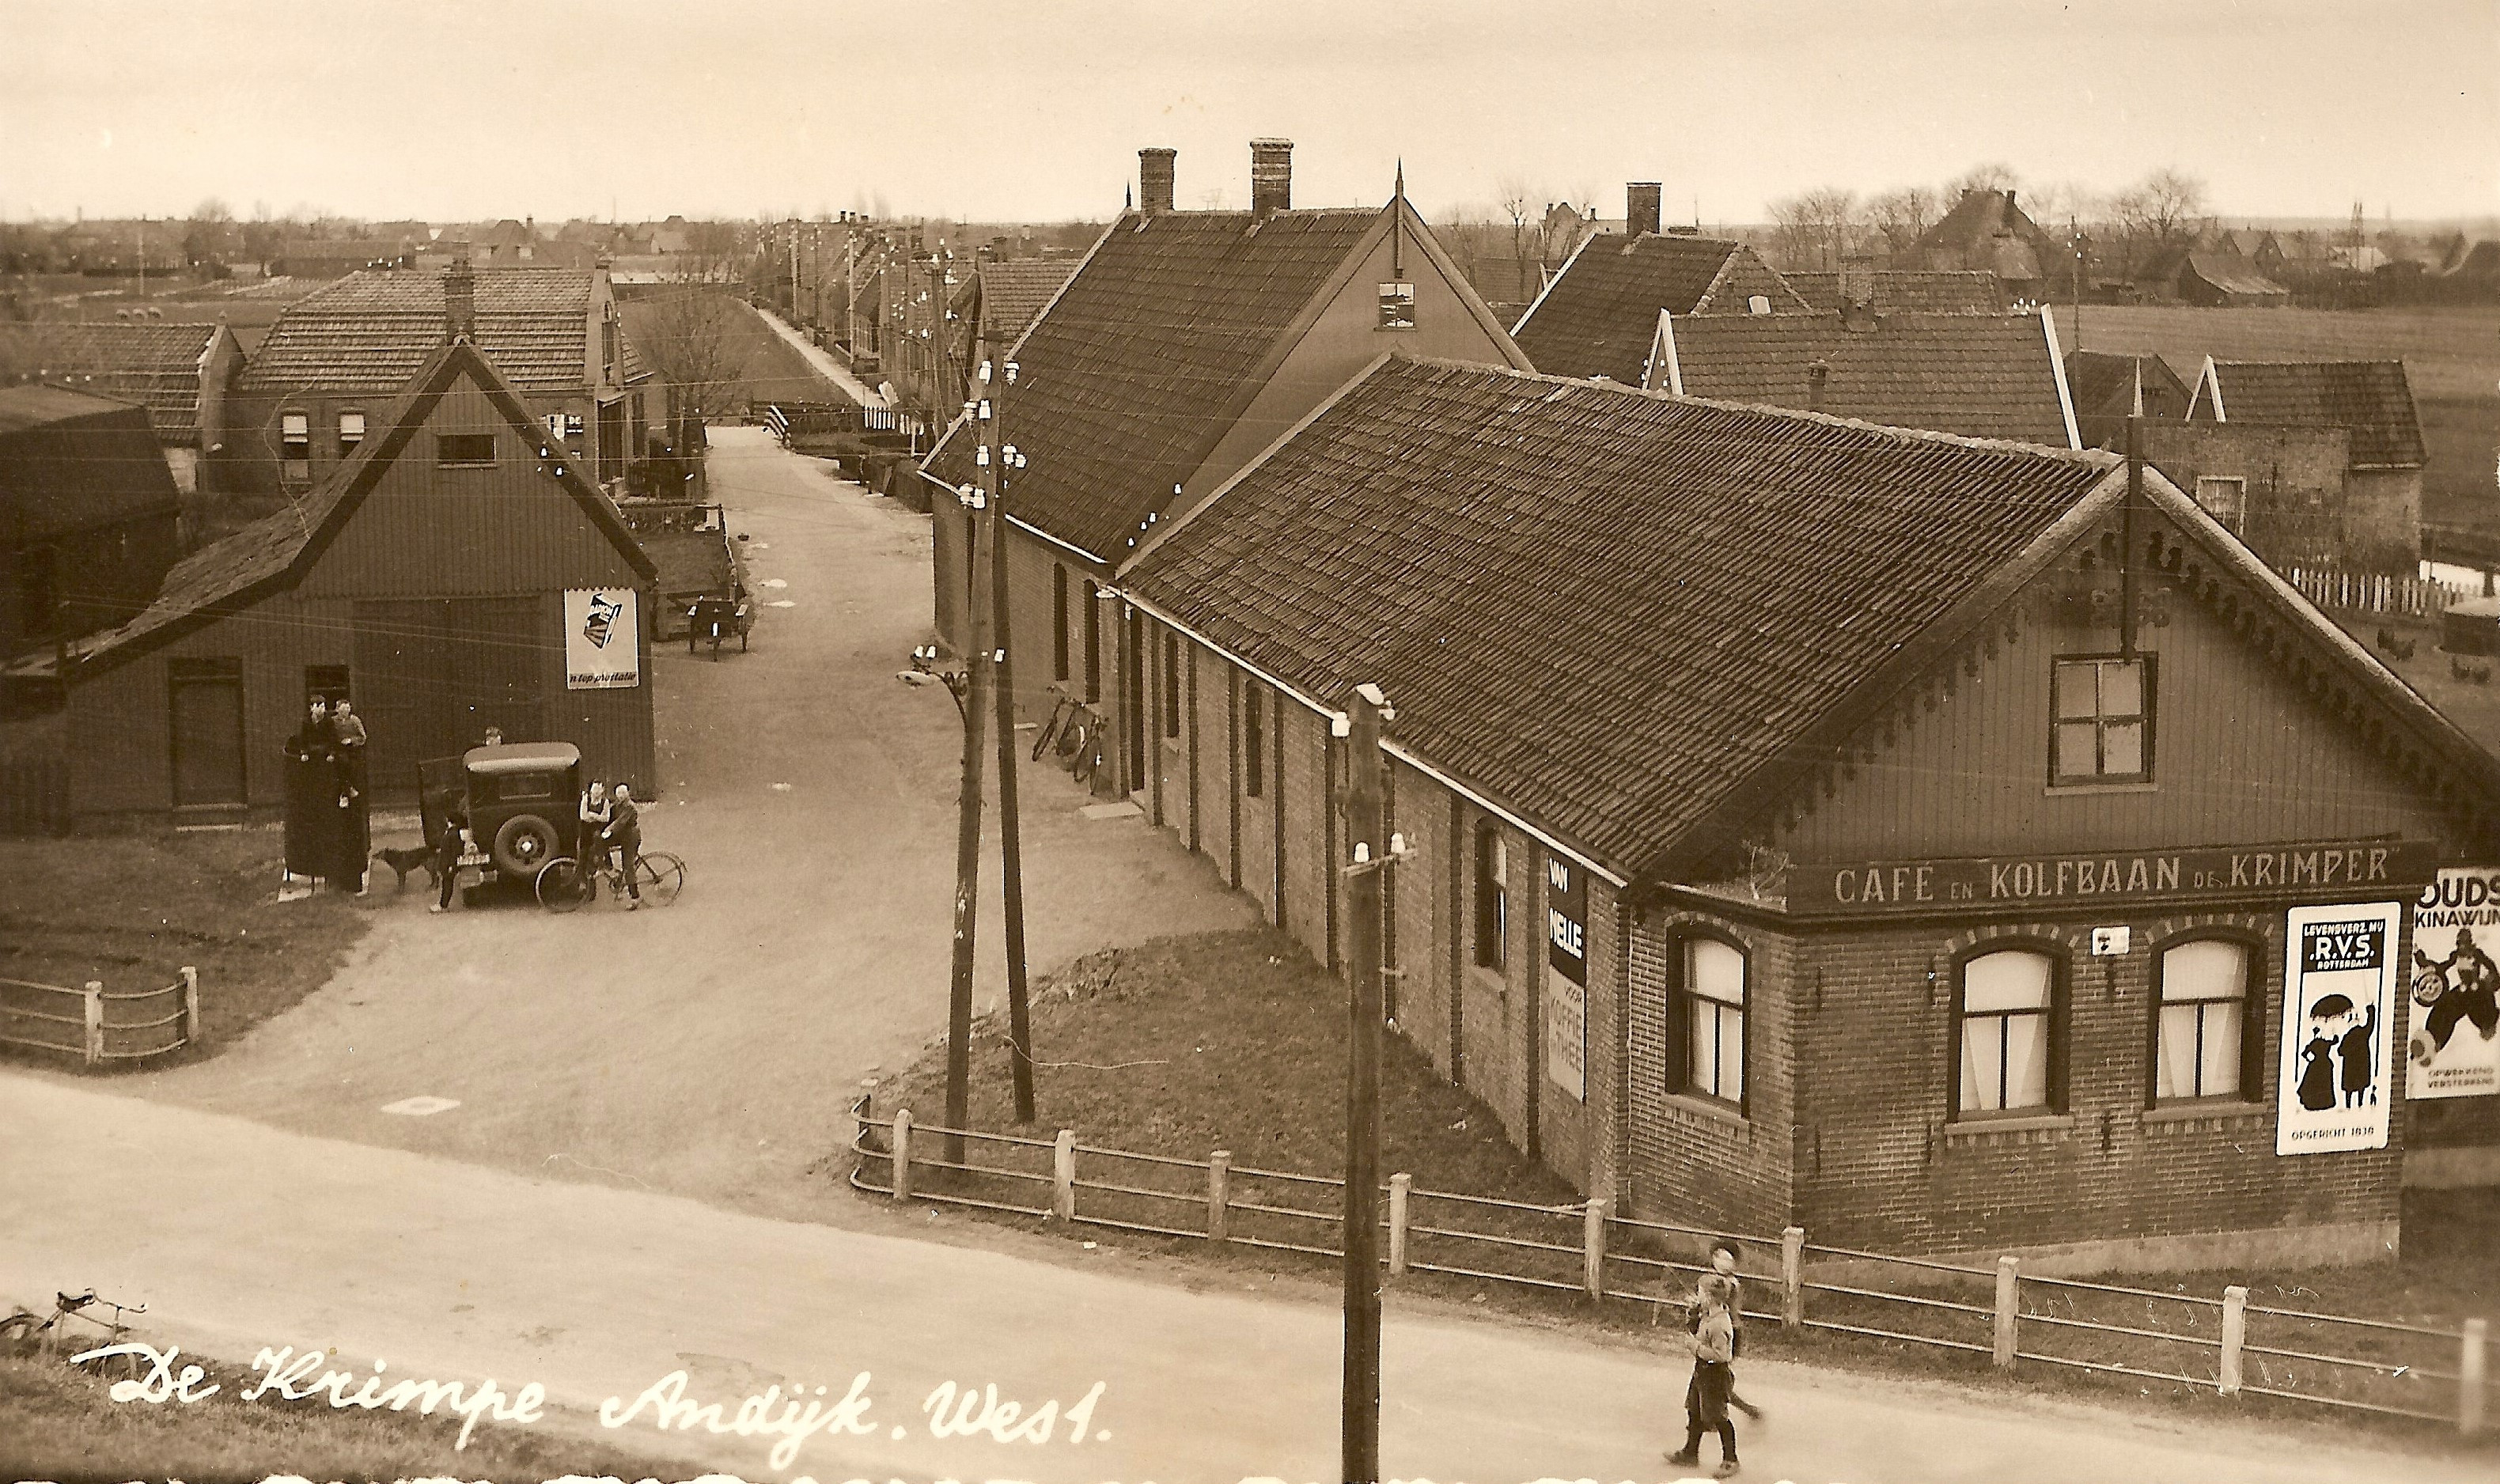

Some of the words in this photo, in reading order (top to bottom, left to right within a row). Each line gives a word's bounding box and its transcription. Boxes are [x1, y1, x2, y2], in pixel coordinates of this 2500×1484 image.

[1950, 880, 1974, 900] EN
[1990, 857, 2180, 899] KOLFBAAN
[1550, 907, 1582, 960] NELLE
[2317, 957, 2369, 970] ROTTERDAM
